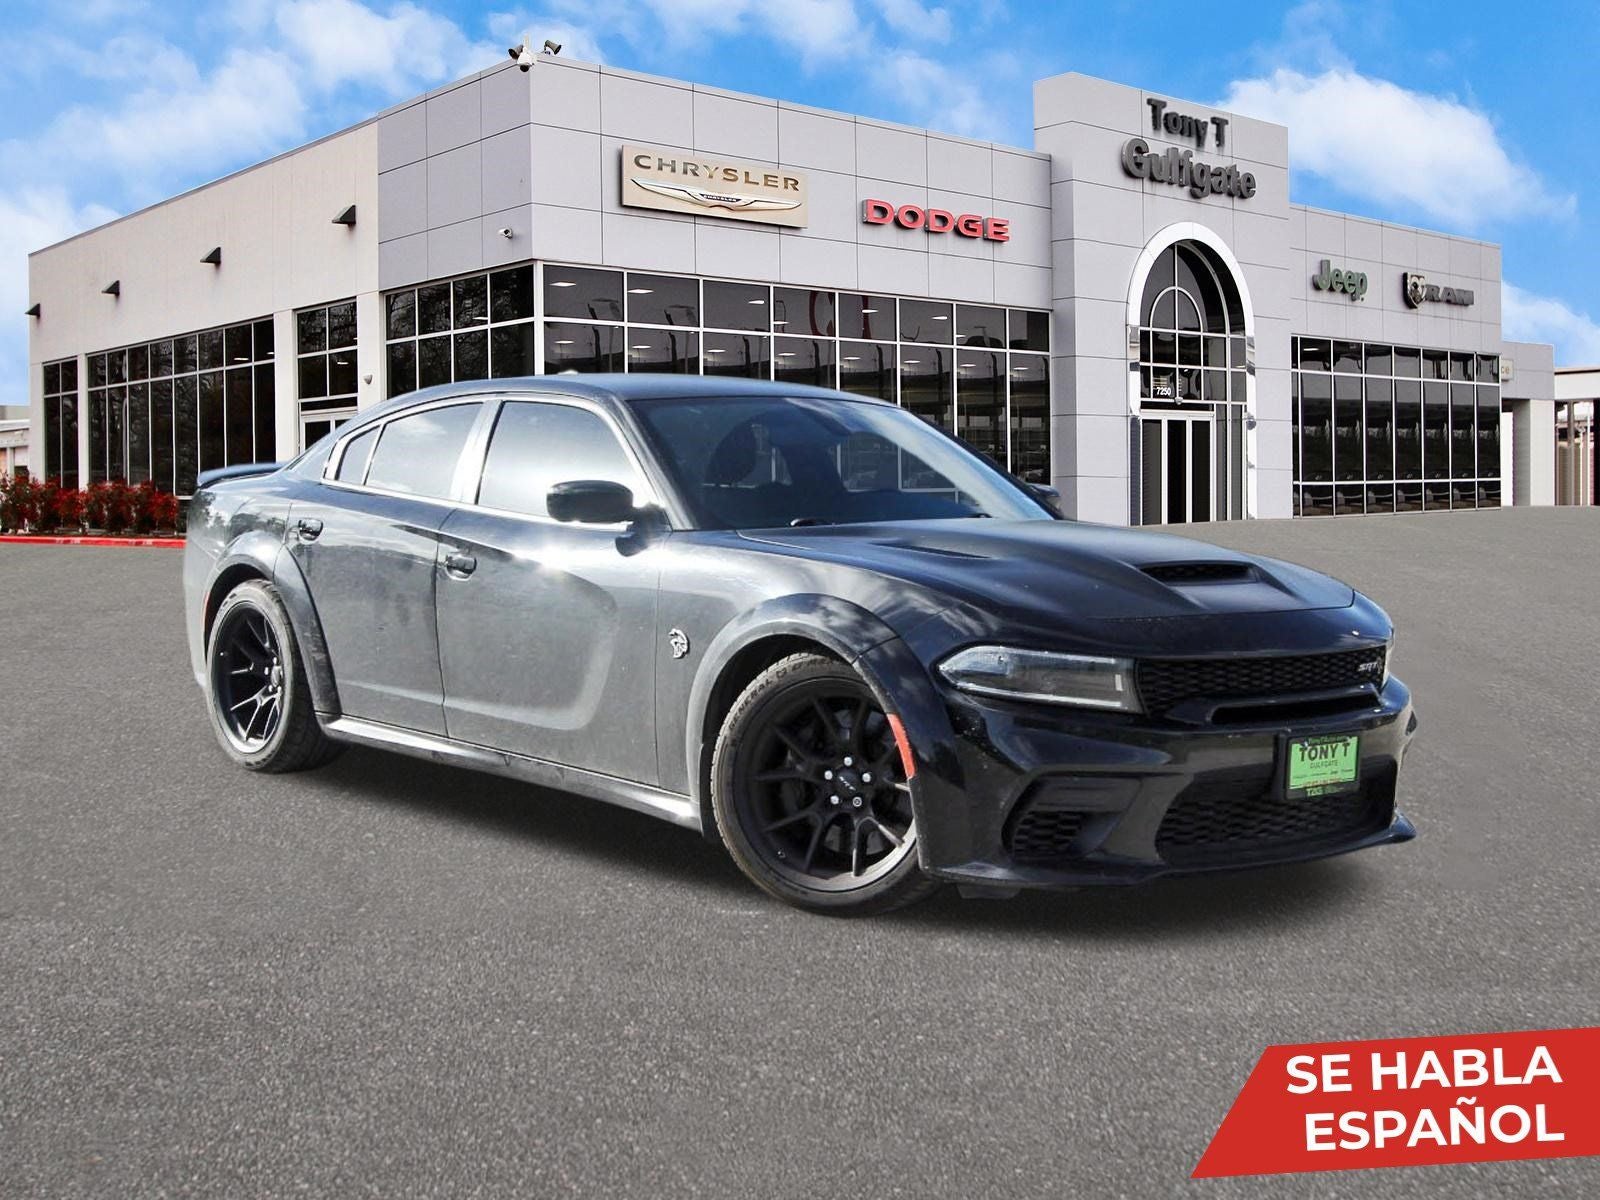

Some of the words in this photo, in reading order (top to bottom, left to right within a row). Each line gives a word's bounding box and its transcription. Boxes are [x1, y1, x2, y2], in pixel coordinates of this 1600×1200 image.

[1146, 98, 1208, 148] Tony
[1210, 116, 1229, 147] T
[633, 154, 801, 192] CHRYSLER
[1121, 137, 1256, 199] Gulfgate
[862, 198, 1010, 242] DODGE
[1312, 259, 1368, 302] Jeep
[1424, 283, 1474, 307] RAM
[1156, 386, 1172, 396] 7250
[1299, 744, 1339, 762] TONY
[1342, 742, 1351, 757] T
